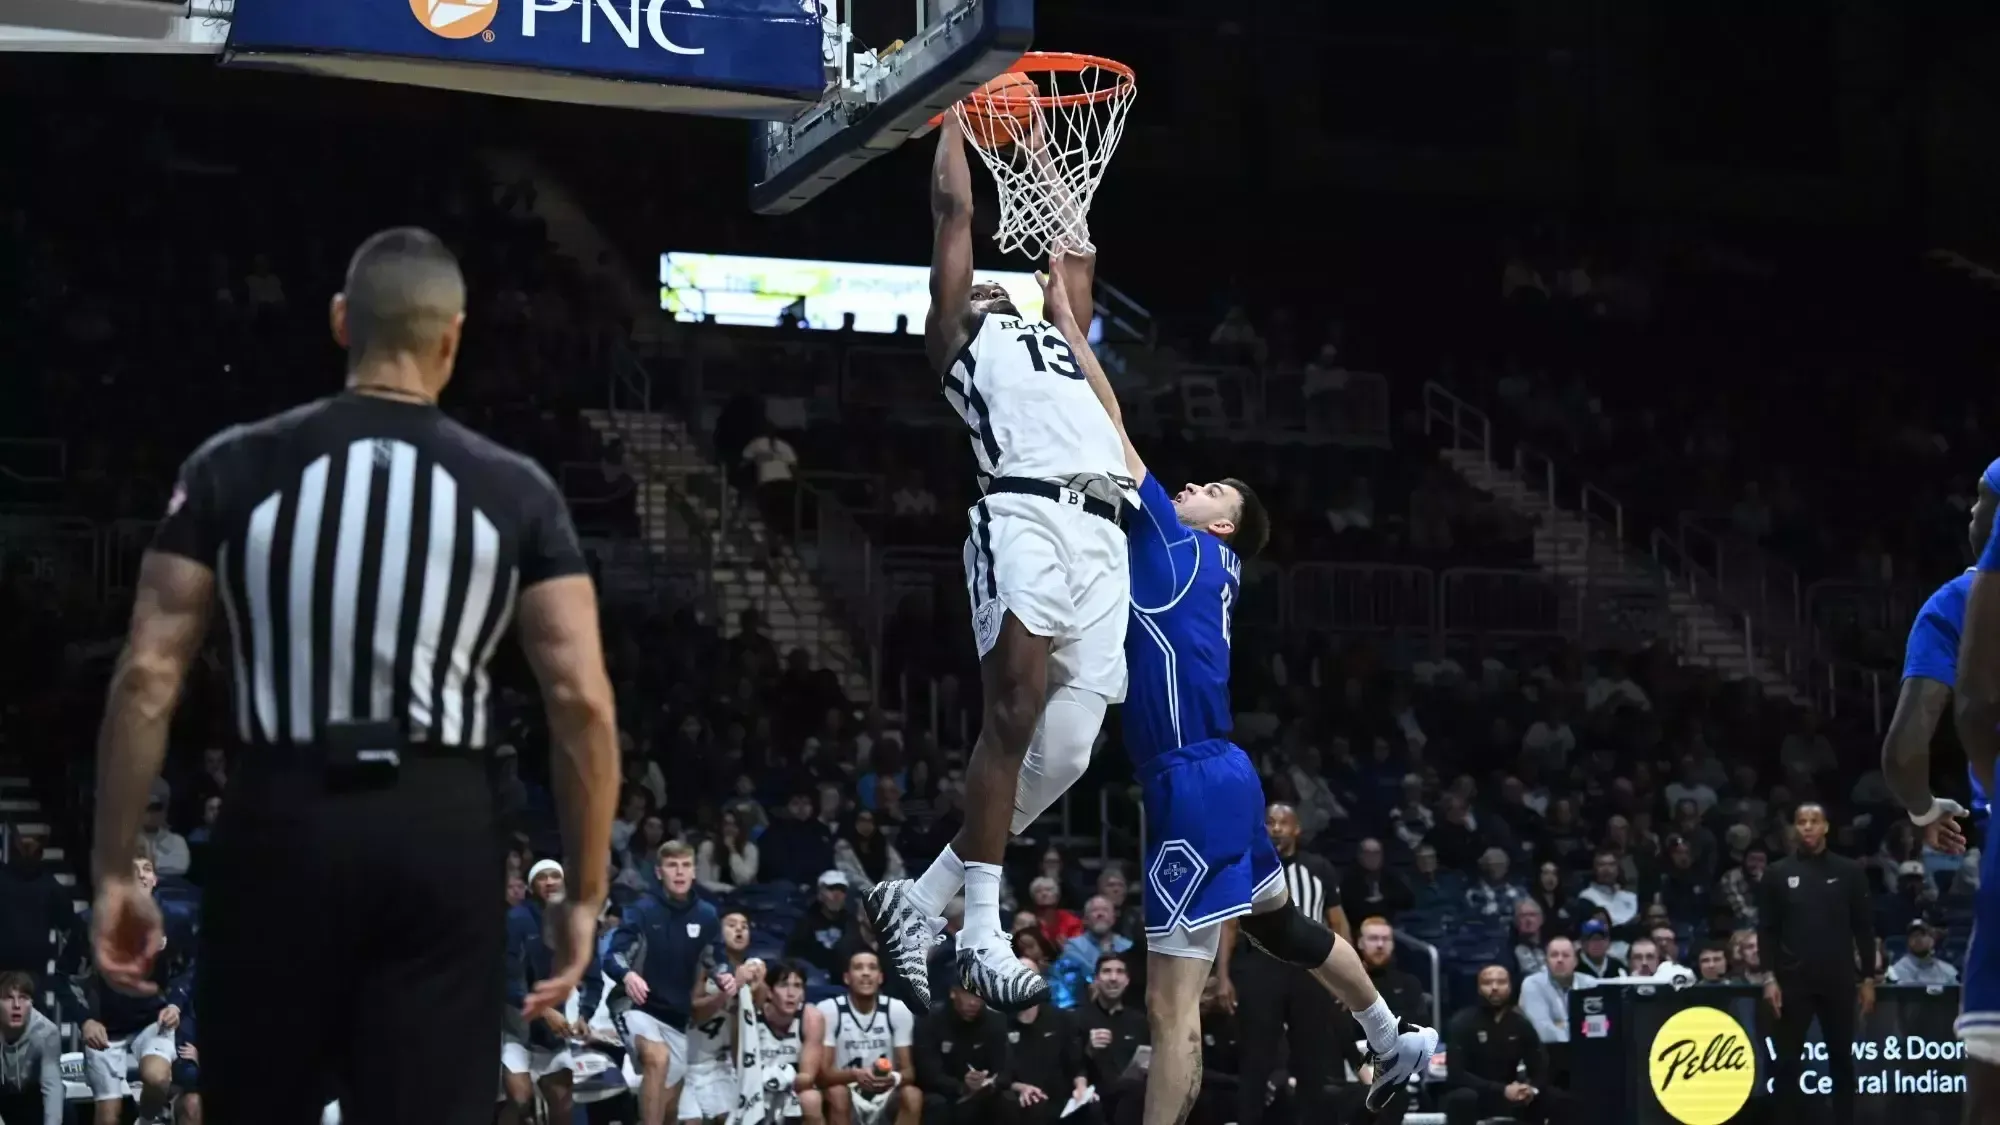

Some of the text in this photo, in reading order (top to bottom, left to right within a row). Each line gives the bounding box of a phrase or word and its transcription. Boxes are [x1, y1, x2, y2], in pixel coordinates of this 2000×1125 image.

[521, 0, 705, 56] PNC
[1000, 320, 1054, 335] BUTL
[1016, 334, 1086, 380] 13
[1067, 491, 1079, 505] B
[1883, 1036, 1902, 1061] &
[1658, 1033, 1747, 1092] Pella
[1799, 1070, 1888, 1094] Ceral
[1895, 1070, 1968, 1093] Indian
